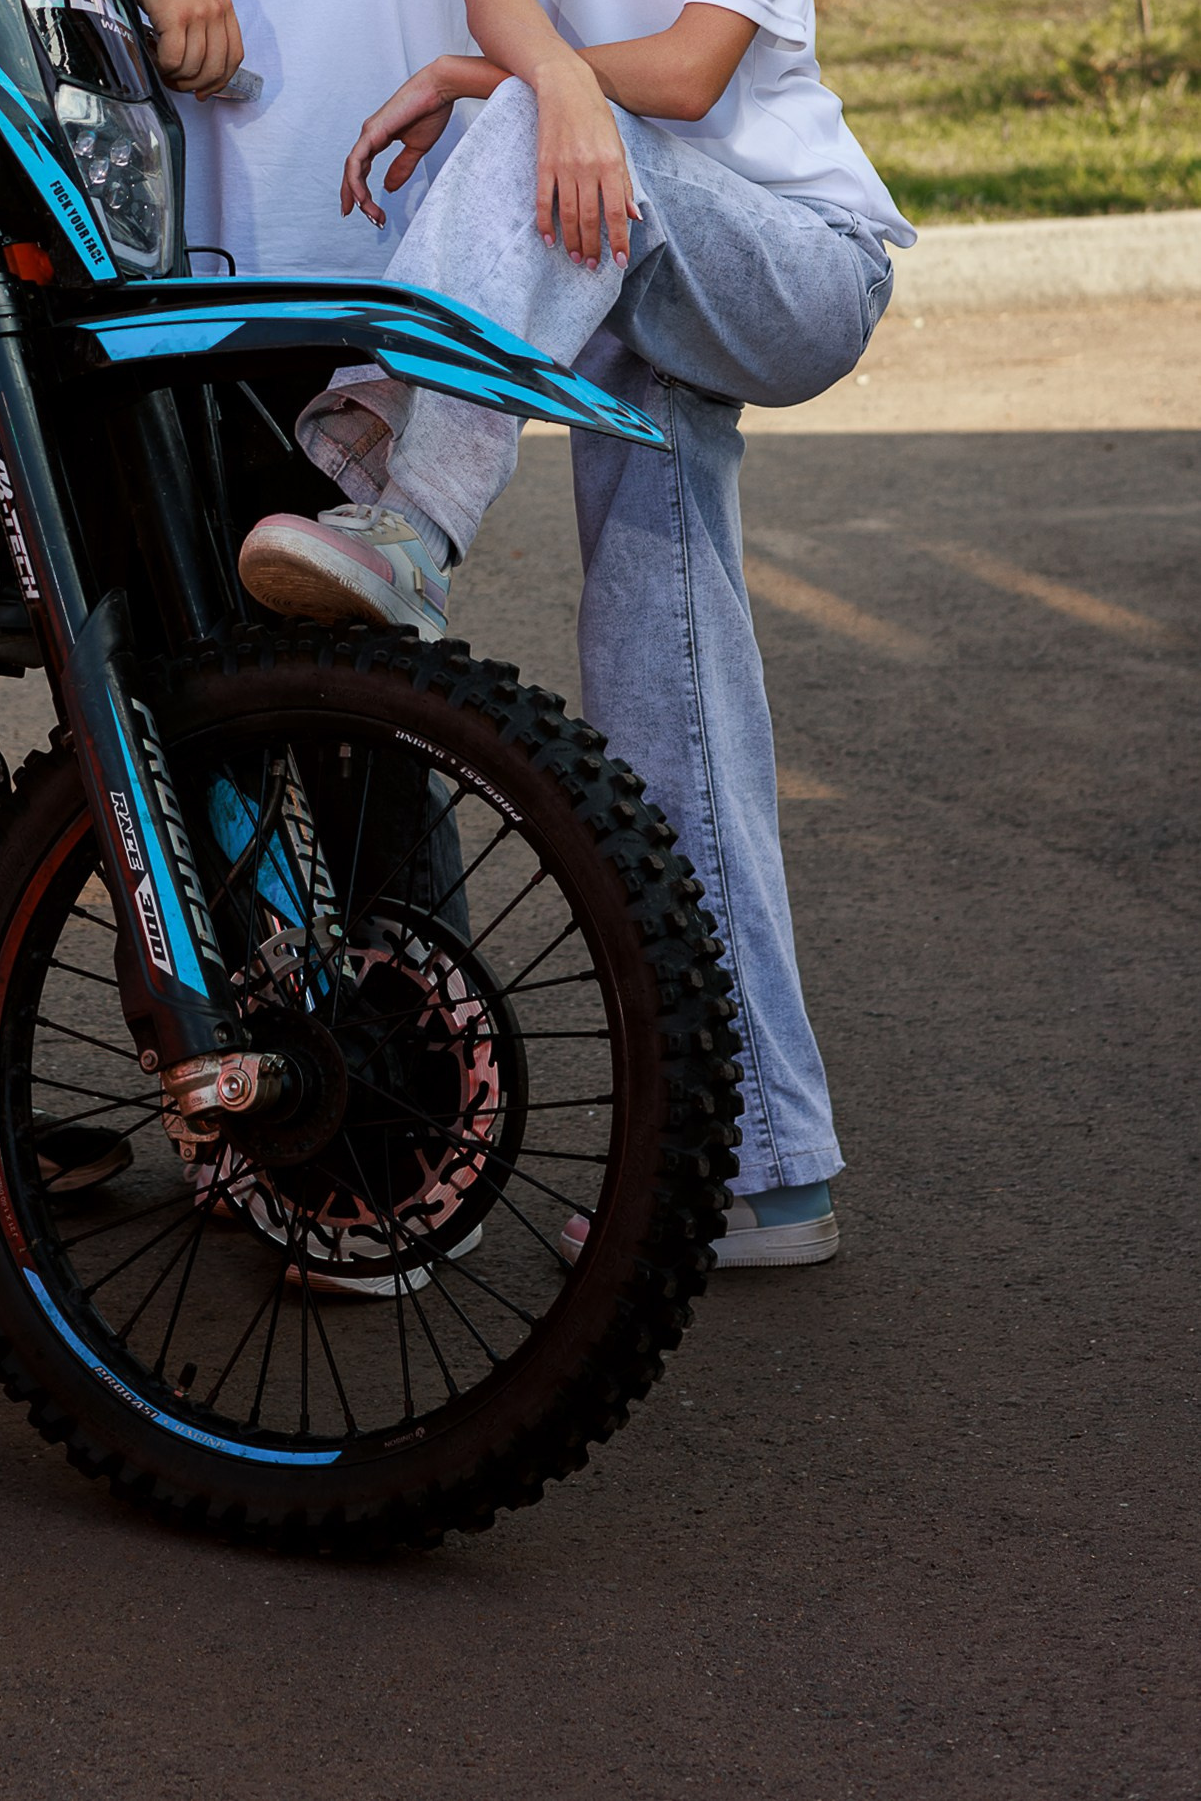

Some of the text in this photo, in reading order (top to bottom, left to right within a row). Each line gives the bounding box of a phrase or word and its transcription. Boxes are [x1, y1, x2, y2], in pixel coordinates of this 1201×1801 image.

[101, 19, 134, 44] WAVE
[49, 179, 105, 265] FUCK YOUR FACE
[458, 763, 524, 824] PROGASI
[110, 791, 144, 871] RACE
[131, 697, 226, 973] PROGASI
[139, 891, 166, 962] 300
[93, 1364, 159, 1420] PROGASI
